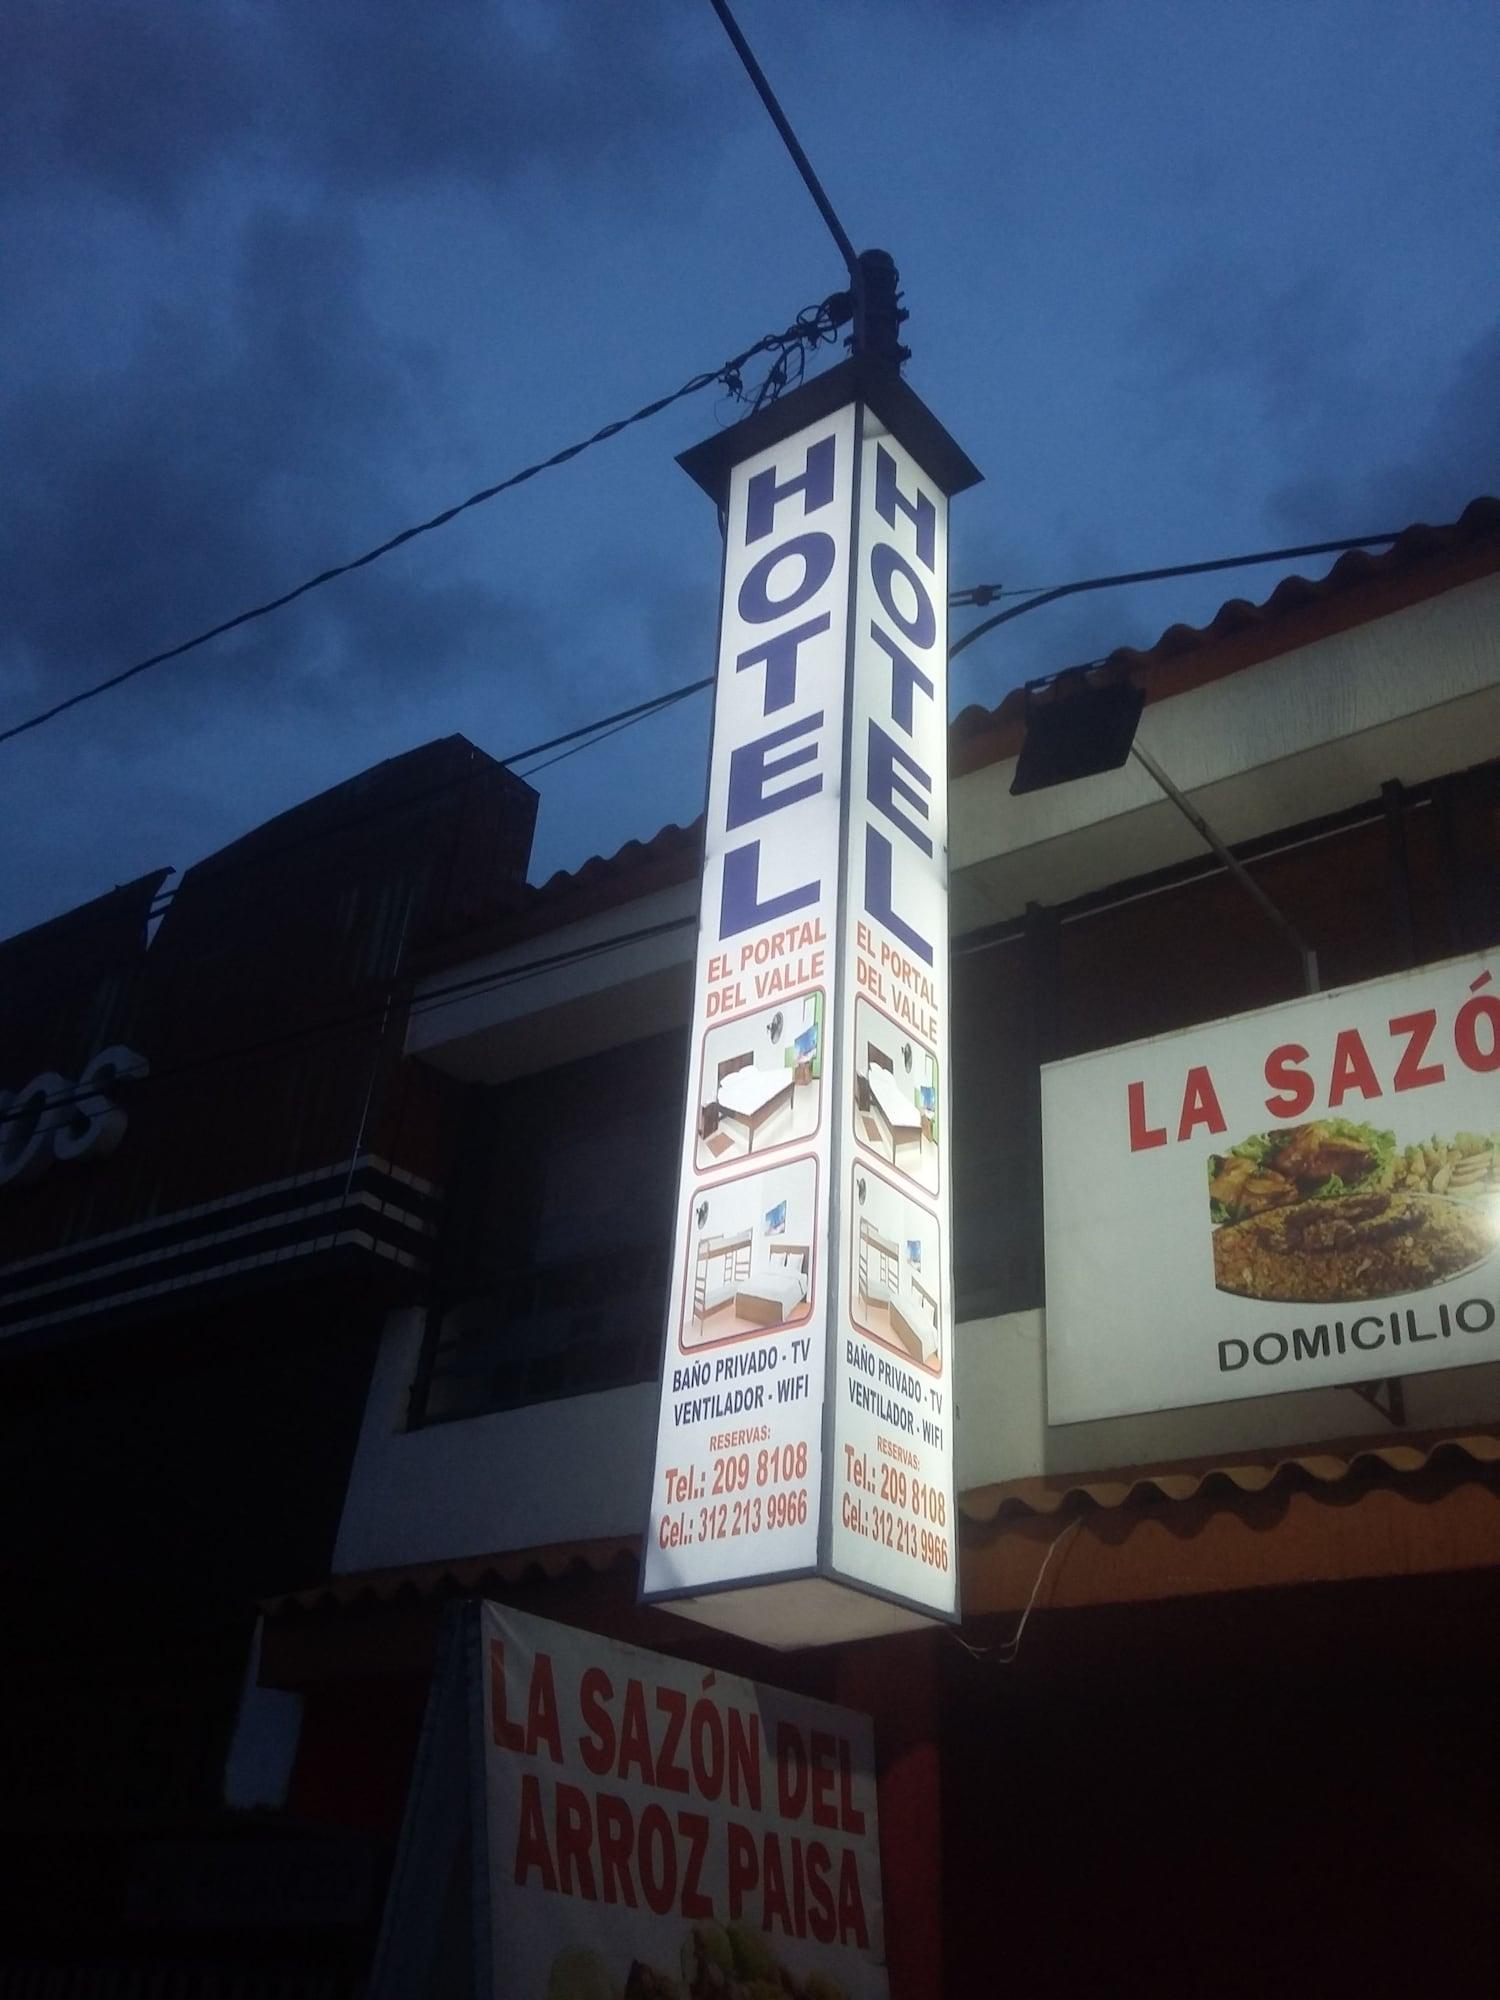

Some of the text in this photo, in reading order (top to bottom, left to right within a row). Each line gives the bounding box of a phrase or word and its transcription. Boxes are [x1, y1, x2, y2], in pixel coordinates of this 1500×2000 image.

[719, 434, 836, 940] HOTEL
[864, 442, 936, 967] HOTEL
[706, 951, 825, 1018] DEL VALLE
[707, 917, 827, 984] EL PORTAL
[857, 920, 939, 1012] EL PORTAL
[857, 955, 938, 1045] DEL VALLE
[1128, 969, 1500, 1152] LA SAZÓ
[672, 1361, 711, 1393] BAÑO
[715, 1346, 778, 1382] PRIVADO
[791, 1338, 811, 1364] TV
[1217, 1298, 1496, 1372] DOMICILIO
[674, 1385, 764, 1426] VENTILADOR
[777, 1374, 809, 1403] WIFI
[846, 1339, 876, 1377] BAÑO
[878, 1358, 922, 1403] PRIVADO
[930, 1389, 943, 1415] TV
[848, 1377, 914, 1436] VENTILADOR
[922, 1419, 943, 1451] WIFI
[665, 1441, 808, 1504] Tel.: 209 8108
[709, 1425, 771, 1452] RESERVAS:
[877, 1435, 920, 1472] RESERVAS:
[659, 1488, 808, 1549] Cel.: 312 213 9966
[844, 1443, 946, 1527] Tel.: 209 8108
[842, 1491, 948, 1572] Cel.: 312 213 9966
[490, 1639, 866, 1836] LA SAZÓN DEL
[514, 1773, 870, 1950] ARROZ PAISA
